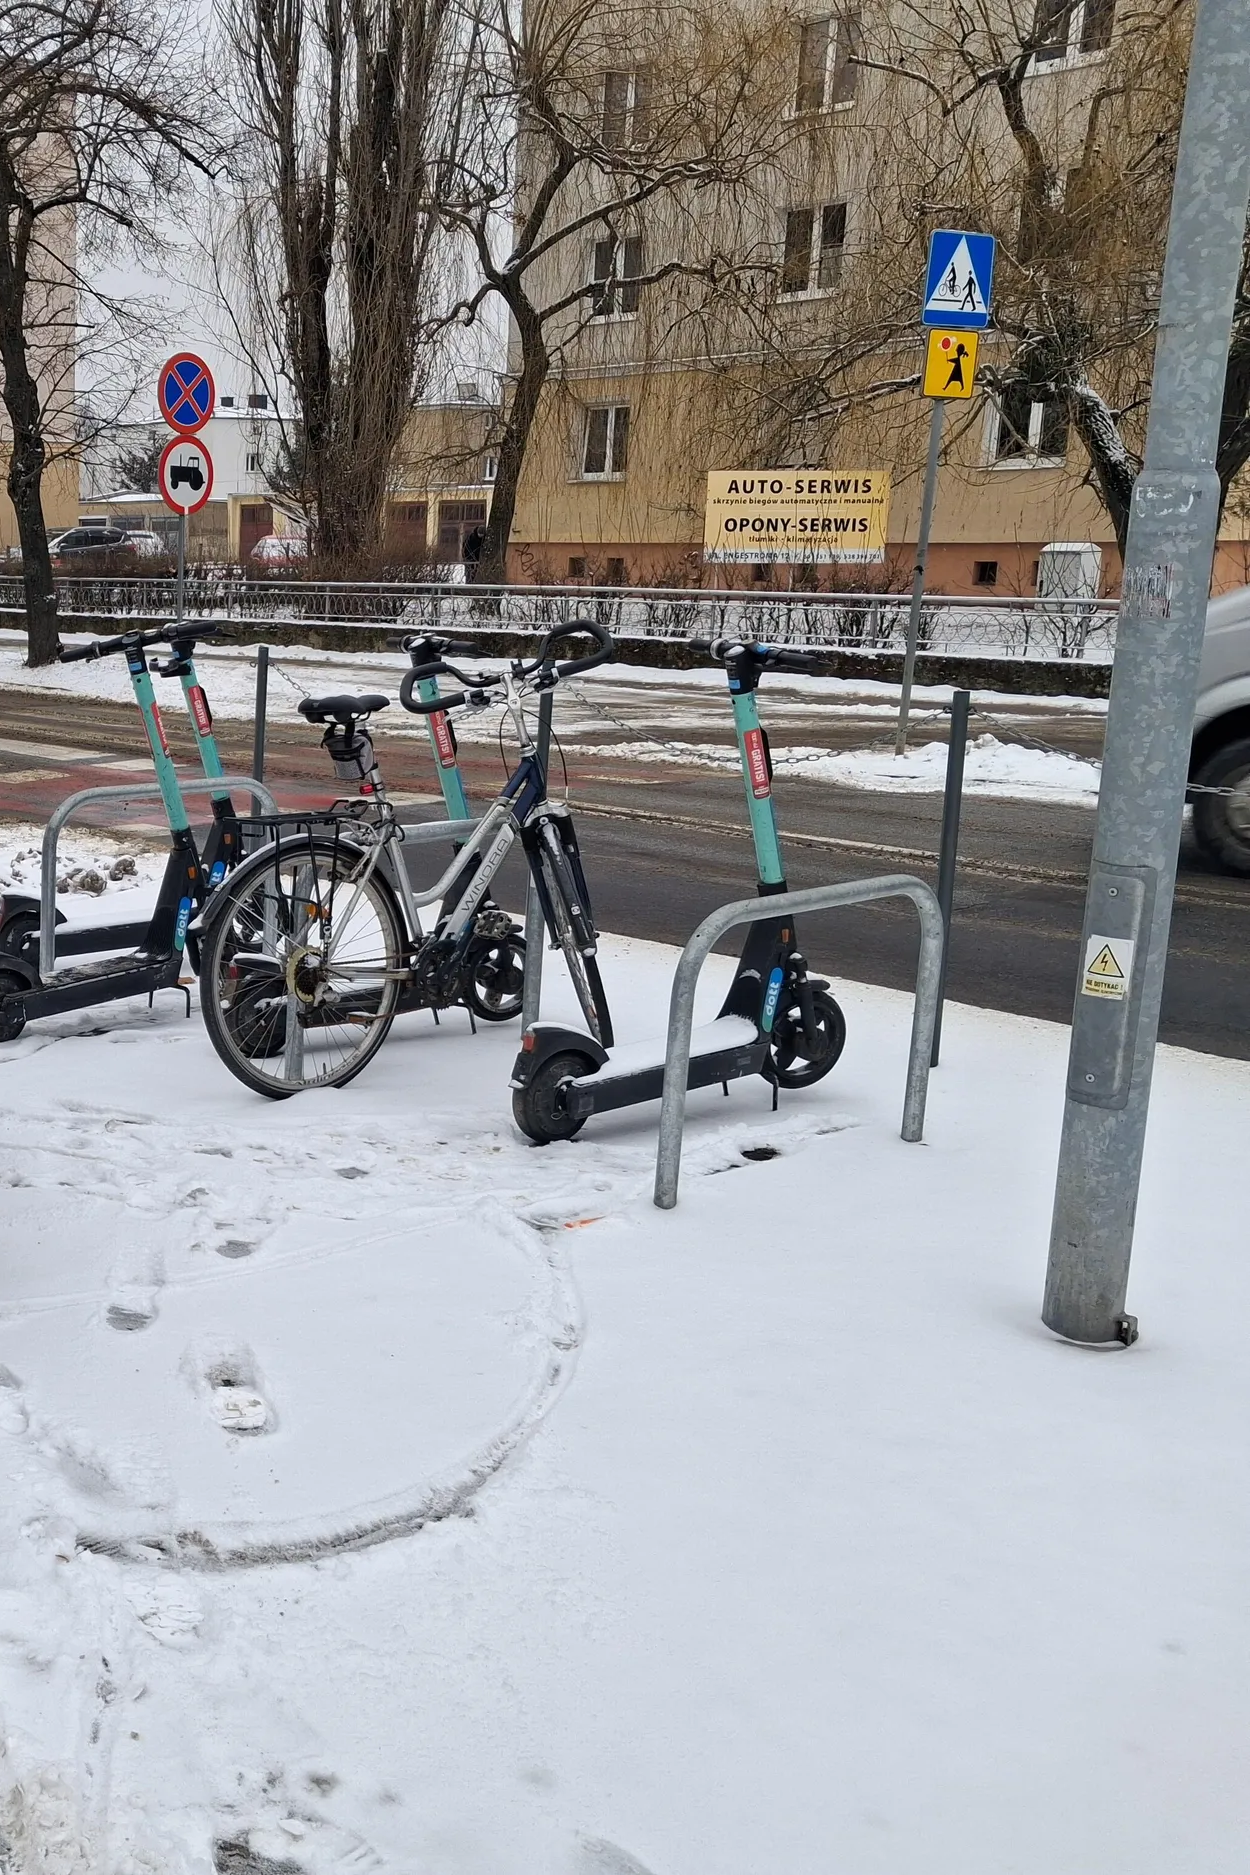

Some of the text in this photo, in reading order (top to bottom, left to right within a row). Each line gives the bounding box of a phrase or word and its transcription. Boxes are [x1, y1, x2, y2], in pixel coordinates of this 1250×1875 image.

[727, 478, 873, 494] AUTO-SERWIS
[712, 496, 748, 506] skrzynie
[748, 496, 779, 507] biegów
[779, 496, 838, 506] automatyczne
[844, 496, 885, 504] manualne
[724, 517, 869, 533] OPONY-SERWIS
[786, 535, 838, 544] klimatyzacja
[461, 838, 509, 911] WINORA
[176, 908, 188, 937] dott
[765, 981, 780, 1017] dott
